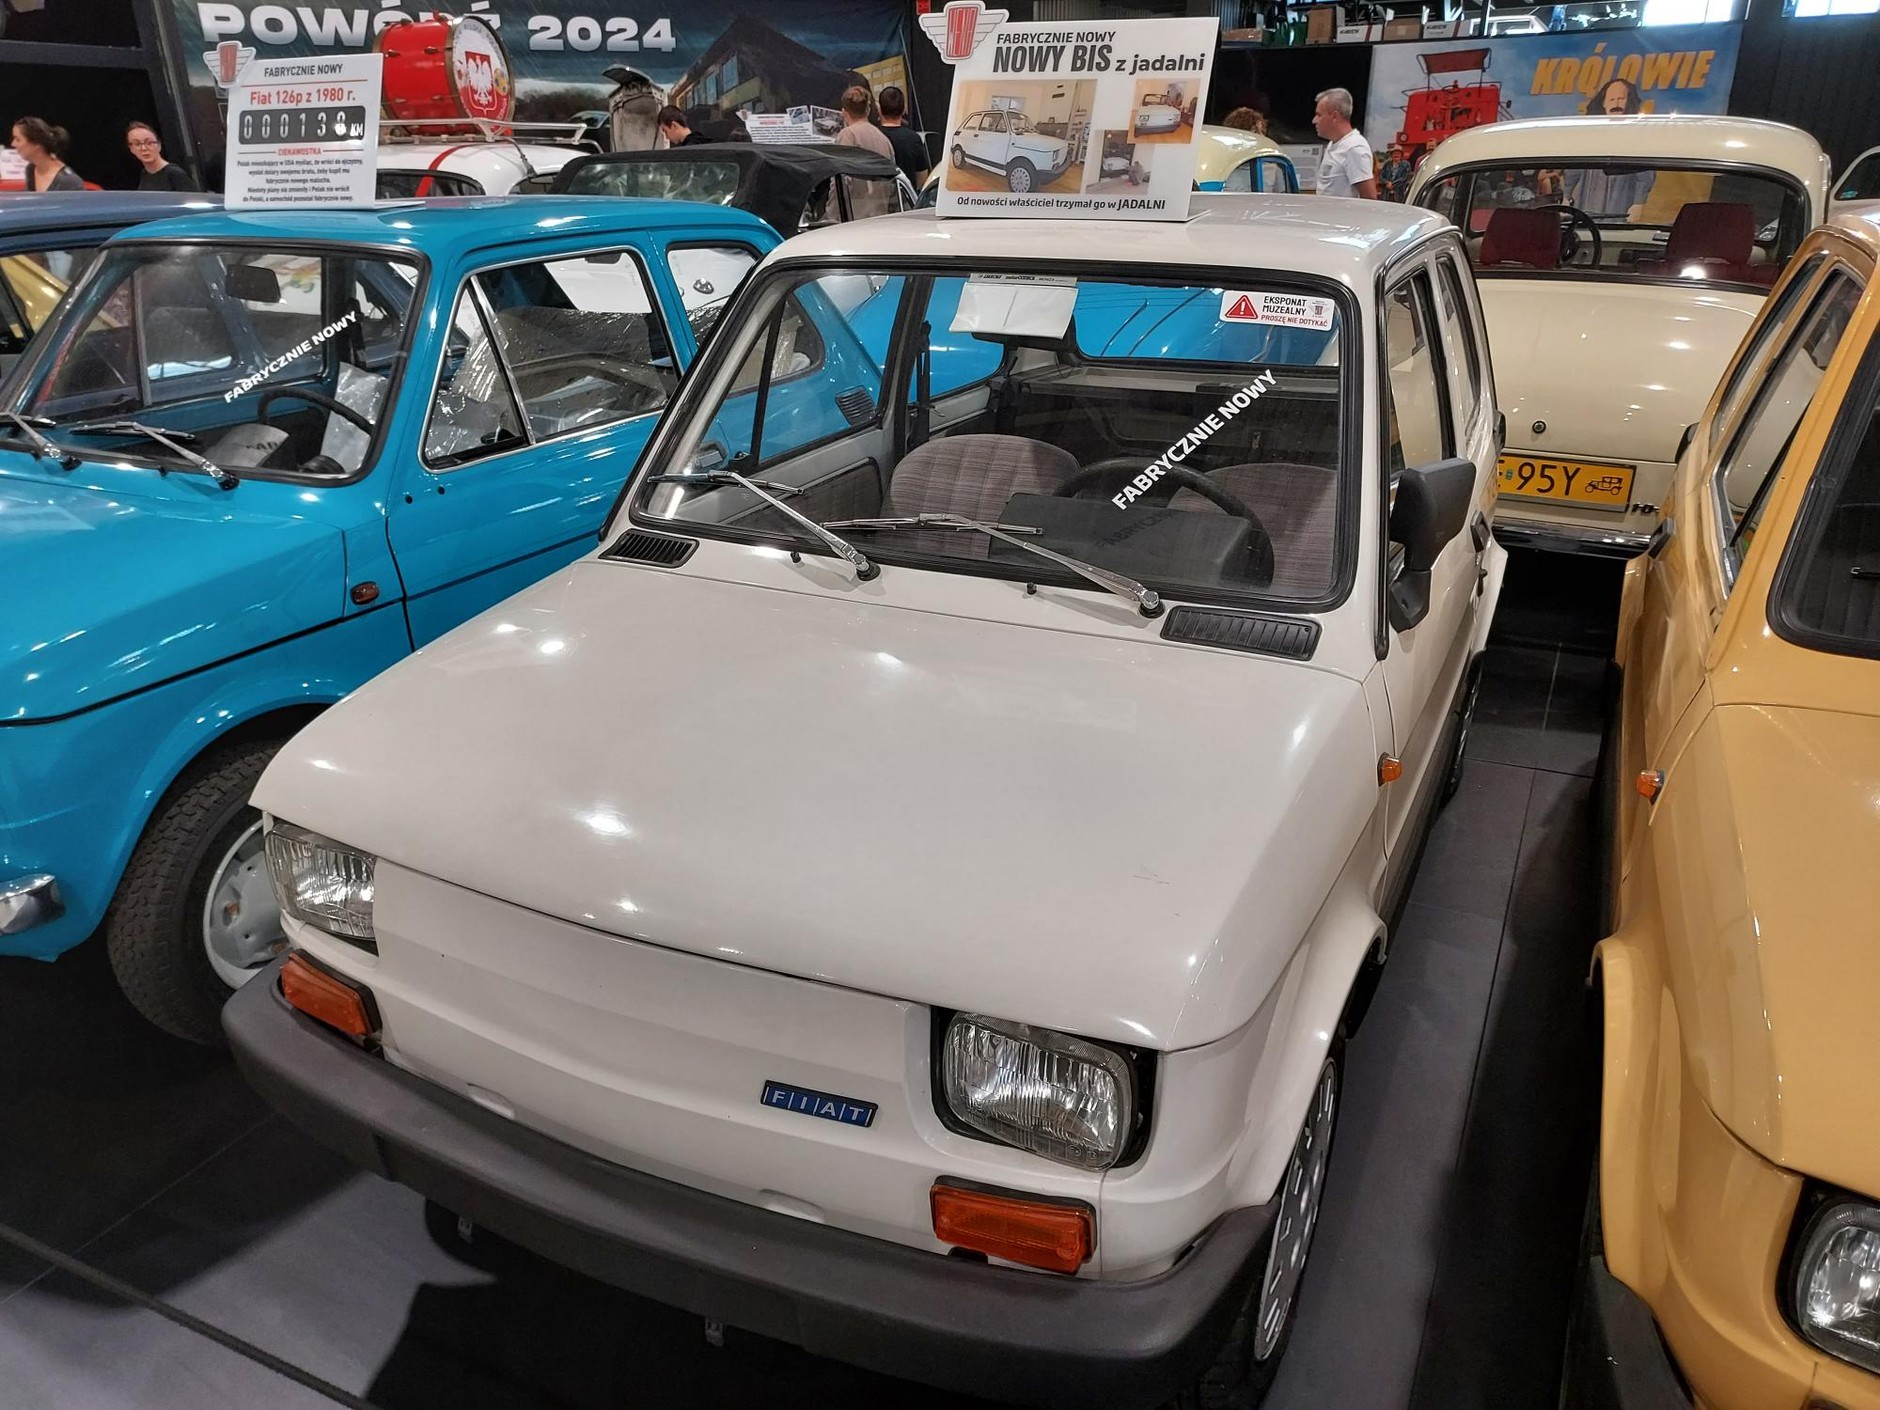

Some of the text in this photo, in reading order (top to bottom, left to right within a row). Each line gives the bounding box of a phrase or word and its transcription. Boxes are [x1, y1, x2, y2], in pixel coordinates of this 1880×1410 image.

[527, 15, 677, 52] 2024
[996, 31, 1117, 44] FABRYCZNIE NOWY
[993, 44, 1206, 76] NOWY BIS z jadalni
[264, 63, 343, 77] FABRYCZNIE NOWY
[250, 87, 356, 106] Fiat 126p z 1980 r.
[957, 196, 1166, 211] Od nowości właściciel trzymał go w JADALNI
[1262, 305, 1307, 316] MUZEALNY
[1263, 295, 1308, 307] EKSPONAT
[1260, 314, 1286, 325] PROSZĘ
[1299, 317, 1328, 327] DOTYKAĆ
[223, 310, 358, 404] FABRYCZNIE NOWY
[1111, 368, 1278, 511] FABRYCZNIE NOWY
[1516, 461, 1582, 496] 95Y
[771, 1090, 865, 1121] FIAT
